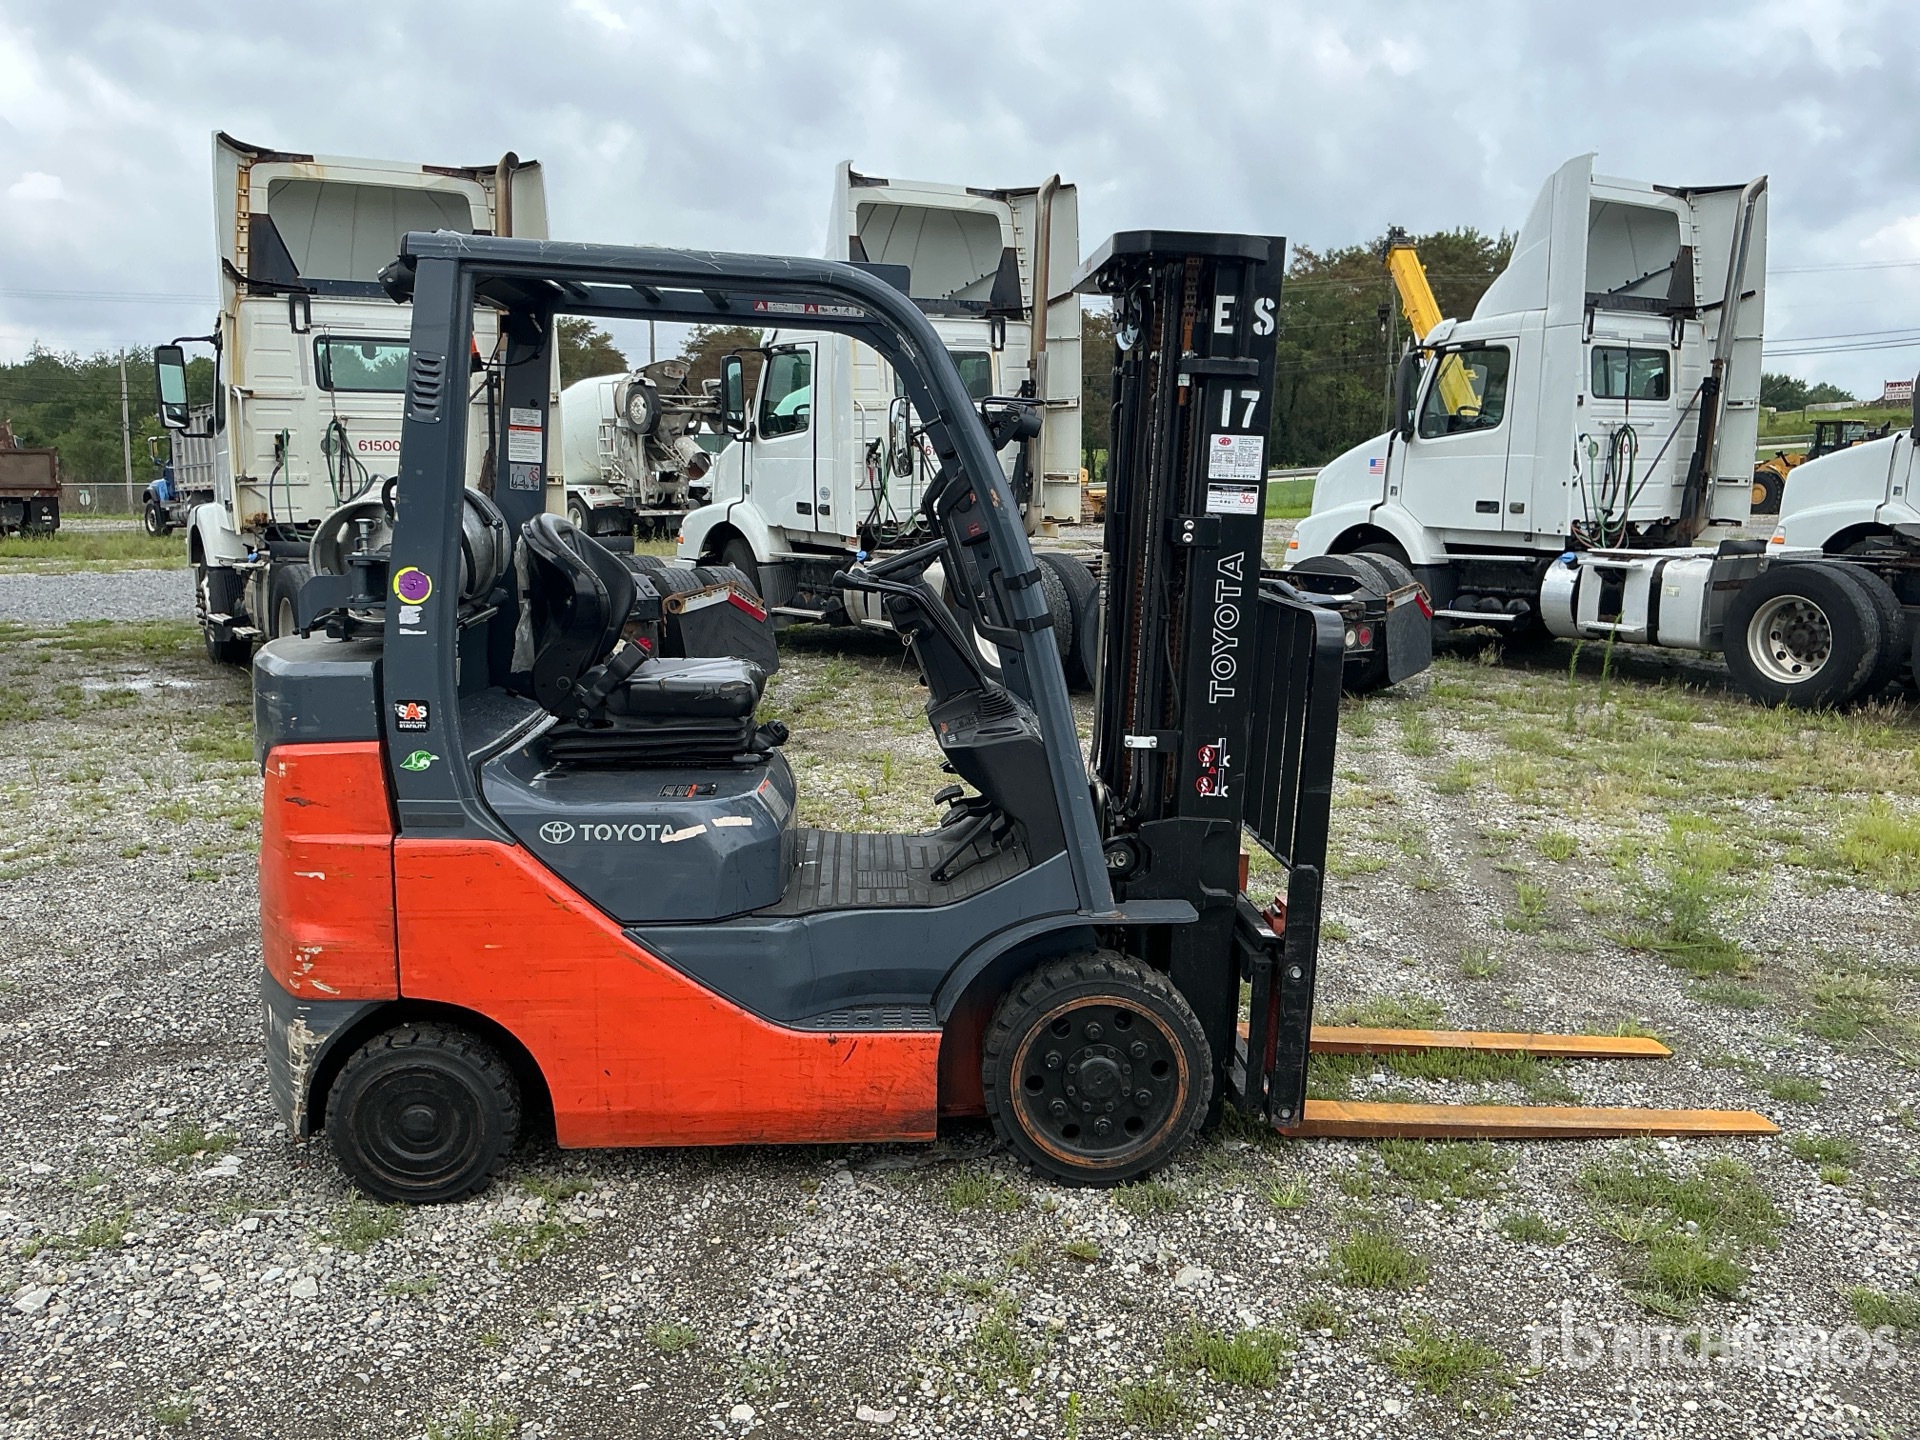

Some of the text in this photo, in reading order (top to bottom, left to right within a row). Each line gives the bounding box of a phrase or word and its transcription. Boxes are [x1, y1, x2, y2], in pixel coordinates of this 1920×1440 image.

[1221, 389, 1260, 428] 17
[1208, 551, 1245, 704] TOYOTA
[398, 703, 427, 720] SAS
[579, 824, 675, 841] TOYOTA
